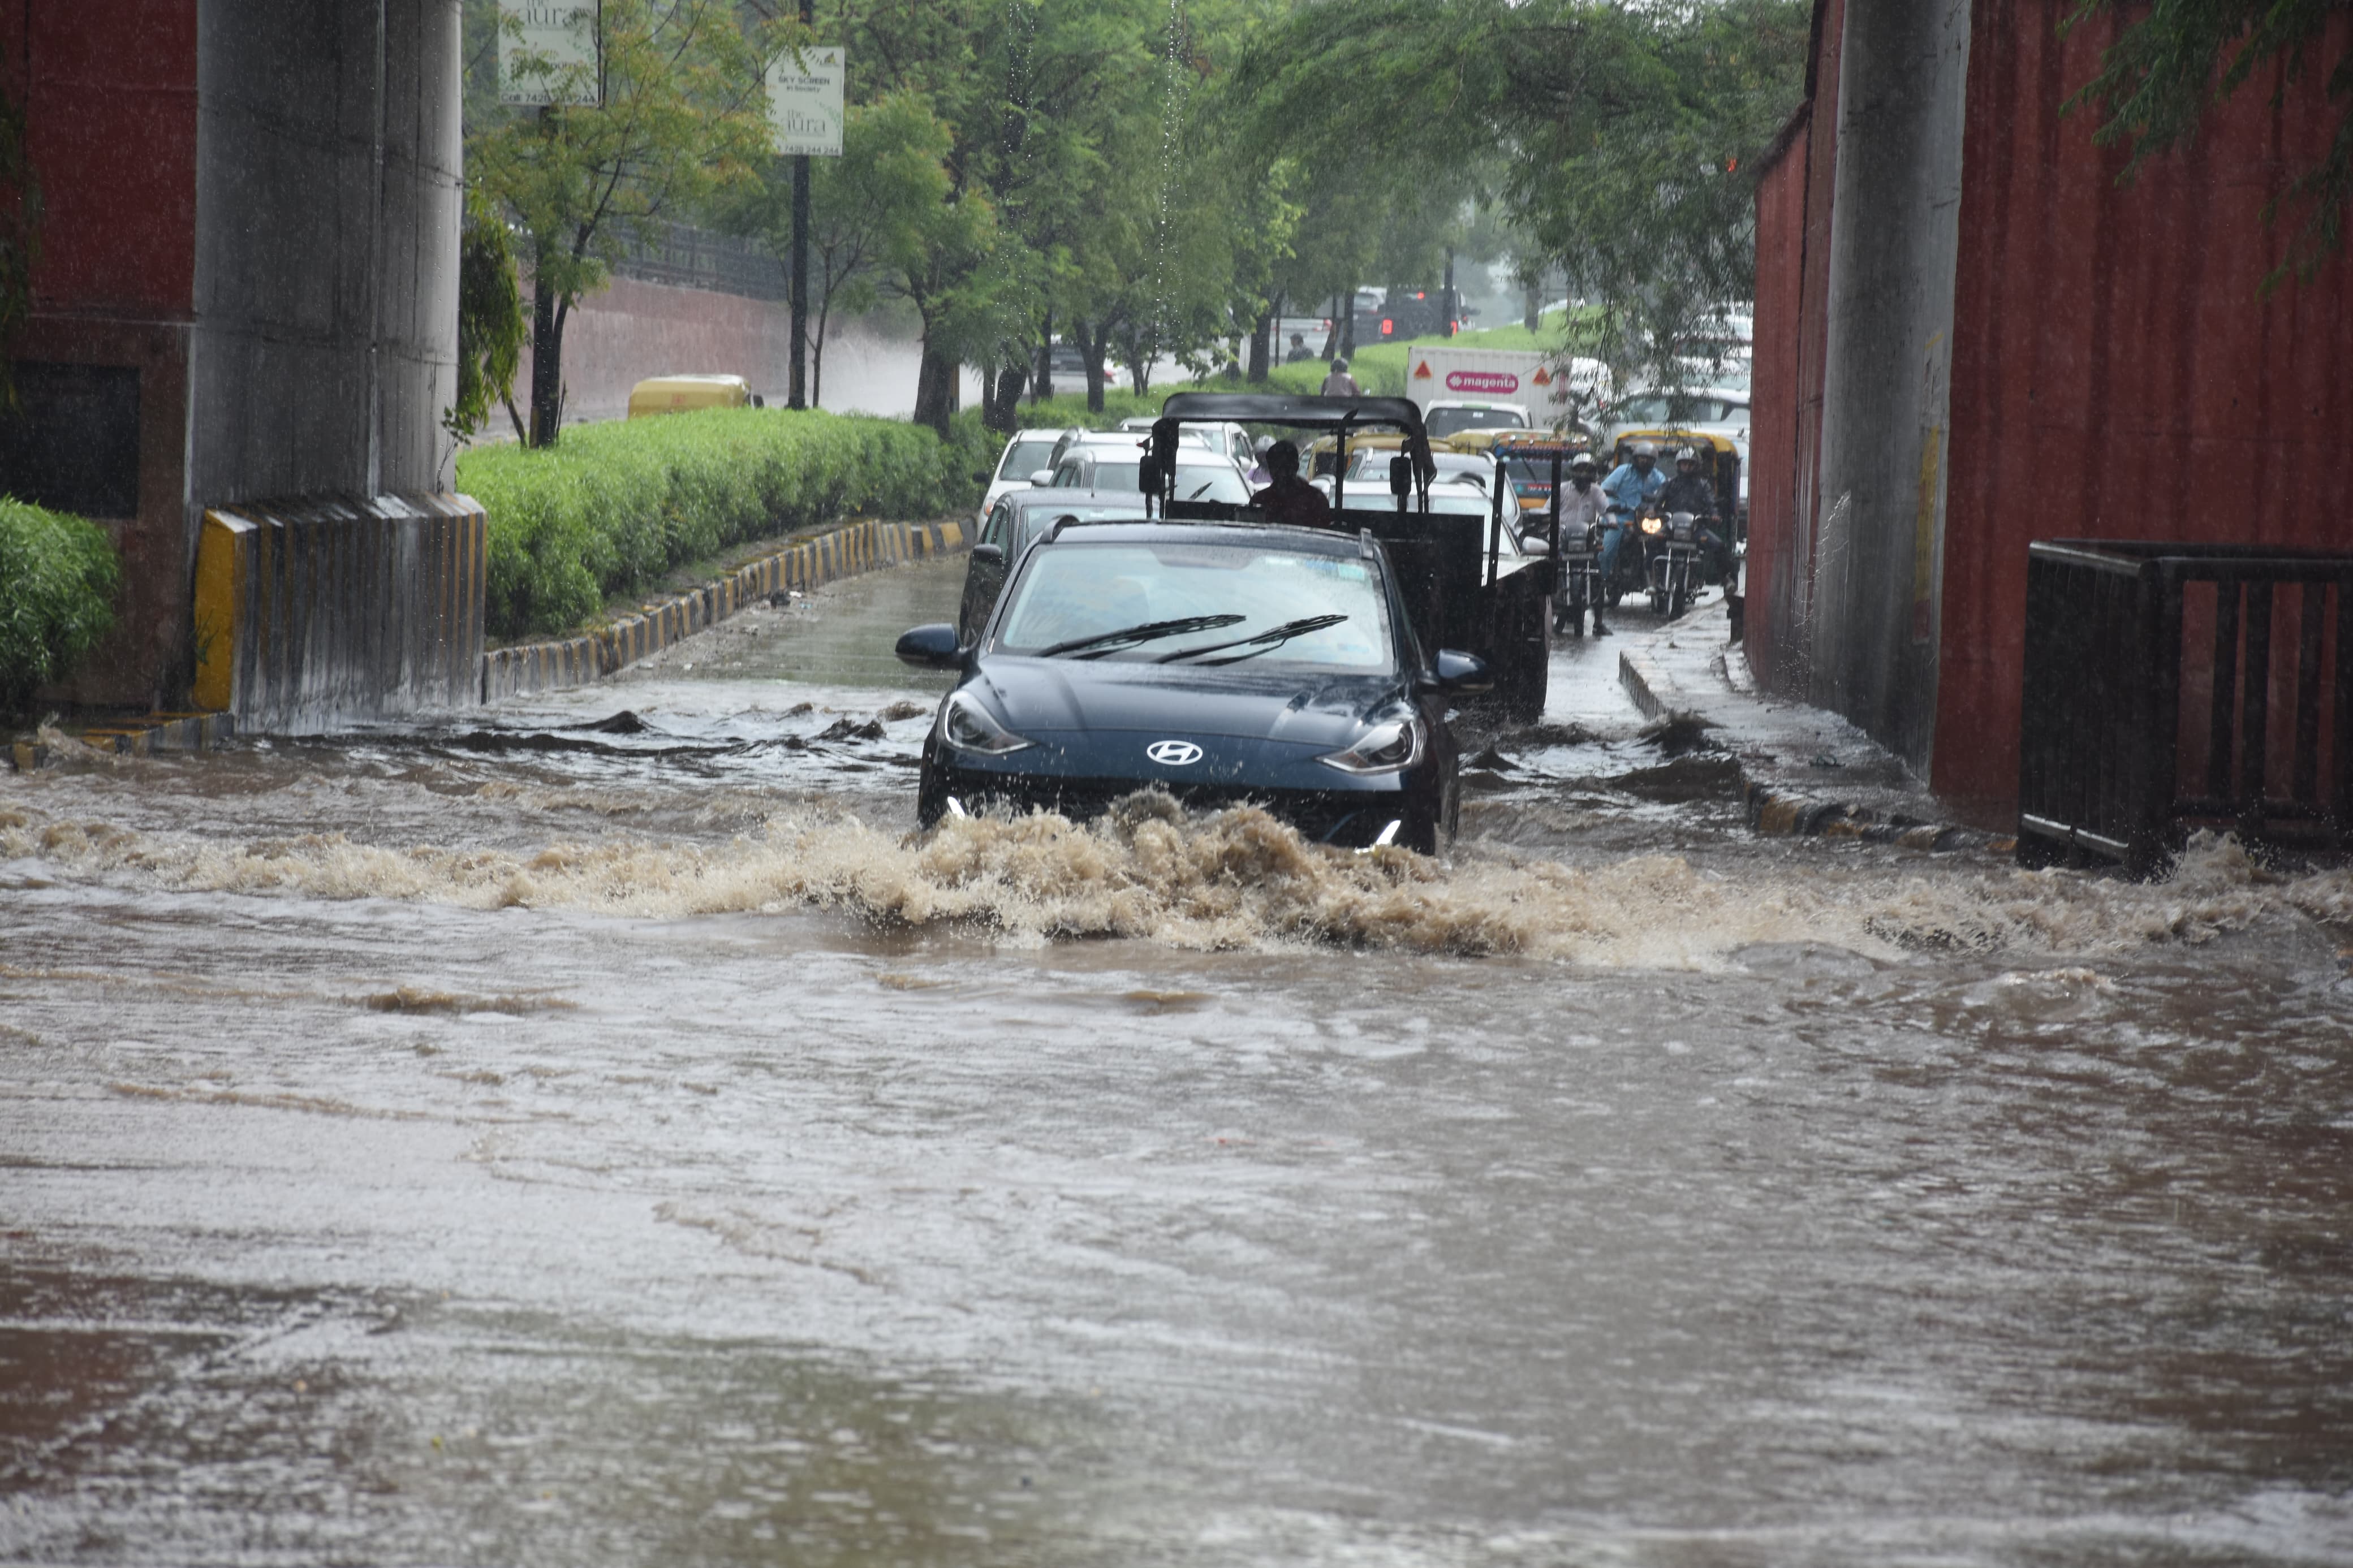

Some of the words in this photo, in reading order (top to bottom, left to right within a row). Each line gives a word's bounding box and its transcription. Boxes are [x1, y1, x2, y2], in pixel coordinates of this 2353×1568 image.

[778, 76, 795, 84] SKY
[798, 76, 830, 85] SCREEN
[501, 93, 521, 103] Call
[1464, 377, 1515, 389] magenta
